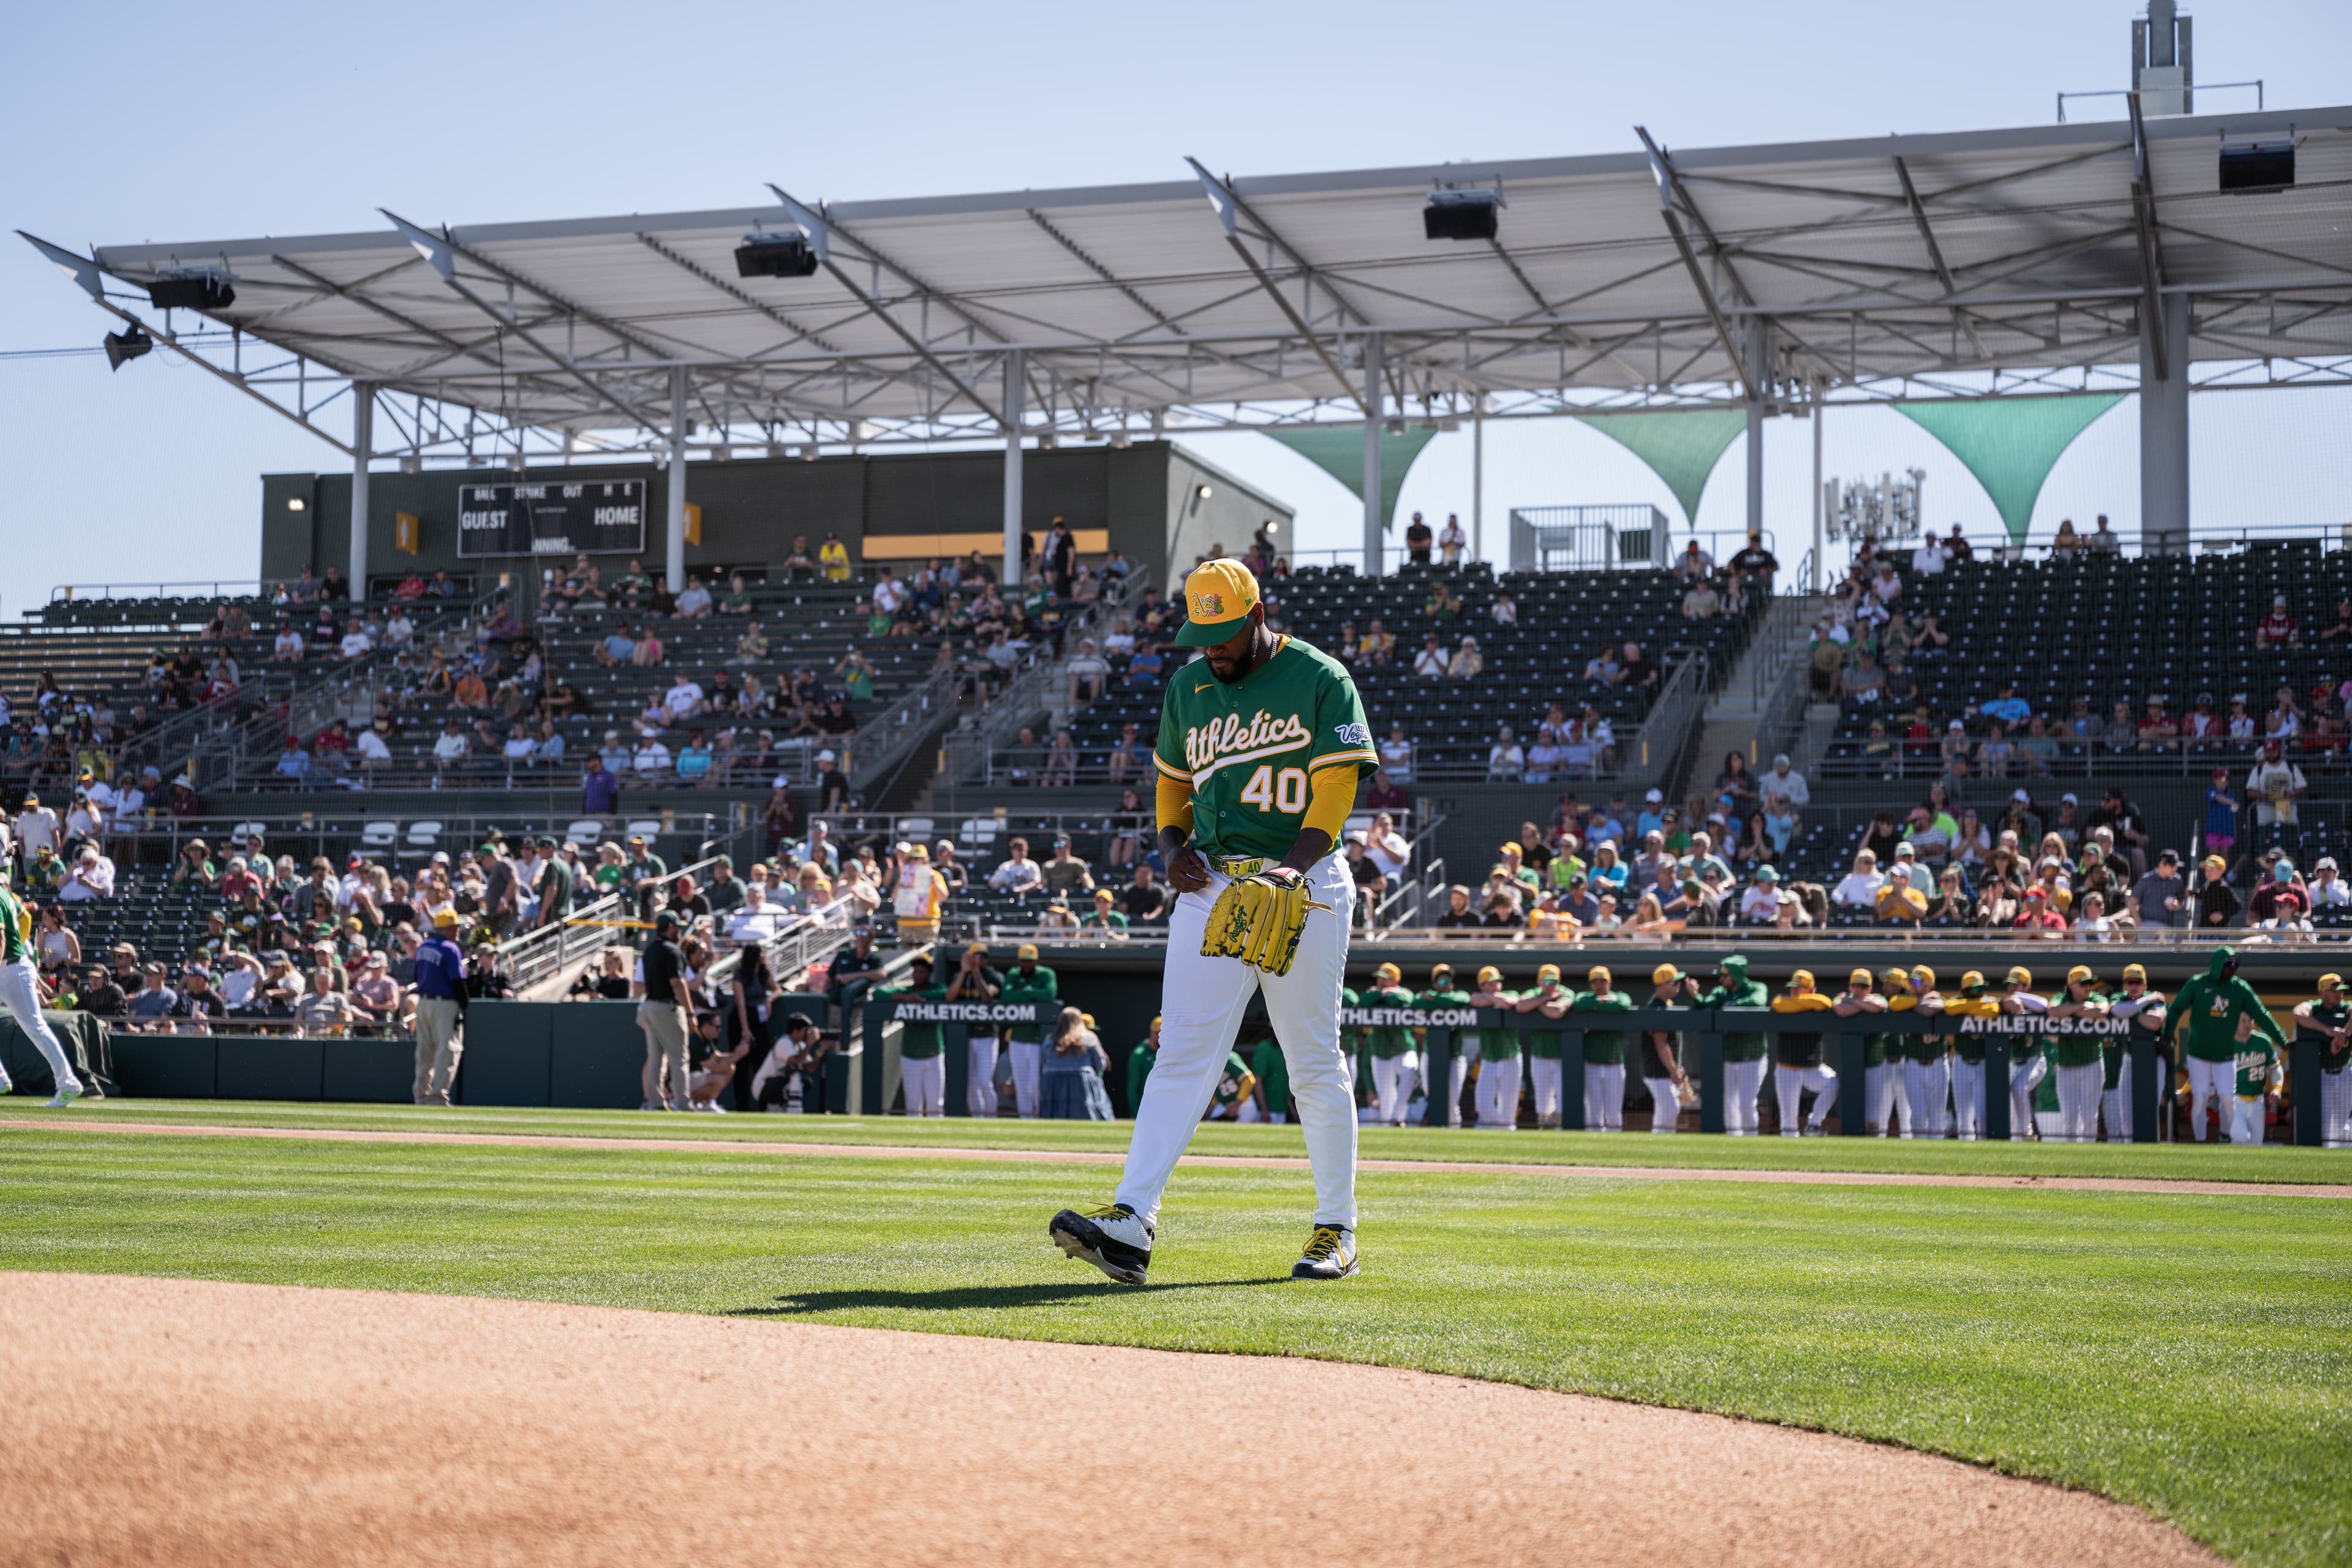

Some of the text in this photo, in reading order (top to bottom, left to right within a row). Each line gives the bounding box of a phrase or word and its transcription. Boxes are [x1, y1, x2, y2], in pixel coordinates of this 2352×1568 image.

[474, 488, 496, 501] BALL
[514, 485, 546, 500] STRIKE
[562, 484, 582, 498] OUT
[462, 506, 639, 530] GUEST HOME
[1191, 592, 1213, 617] A's
[1185, 707, 1311, 772] Athletics
[1240, 765, 1308, 813] 40
[1248, 861, 1261, 874] 40
[1229, 905, 1247, 943] Rawlings
[894, 1004, 1036, 1020] ATHLETICS.COM
[1341, 1008, 1477, 1026] THLETICS.COM
[1961, 1016, 2130, 1035] ATHLETICS.COM
[2248, 1065, 2266, 1082] 25
